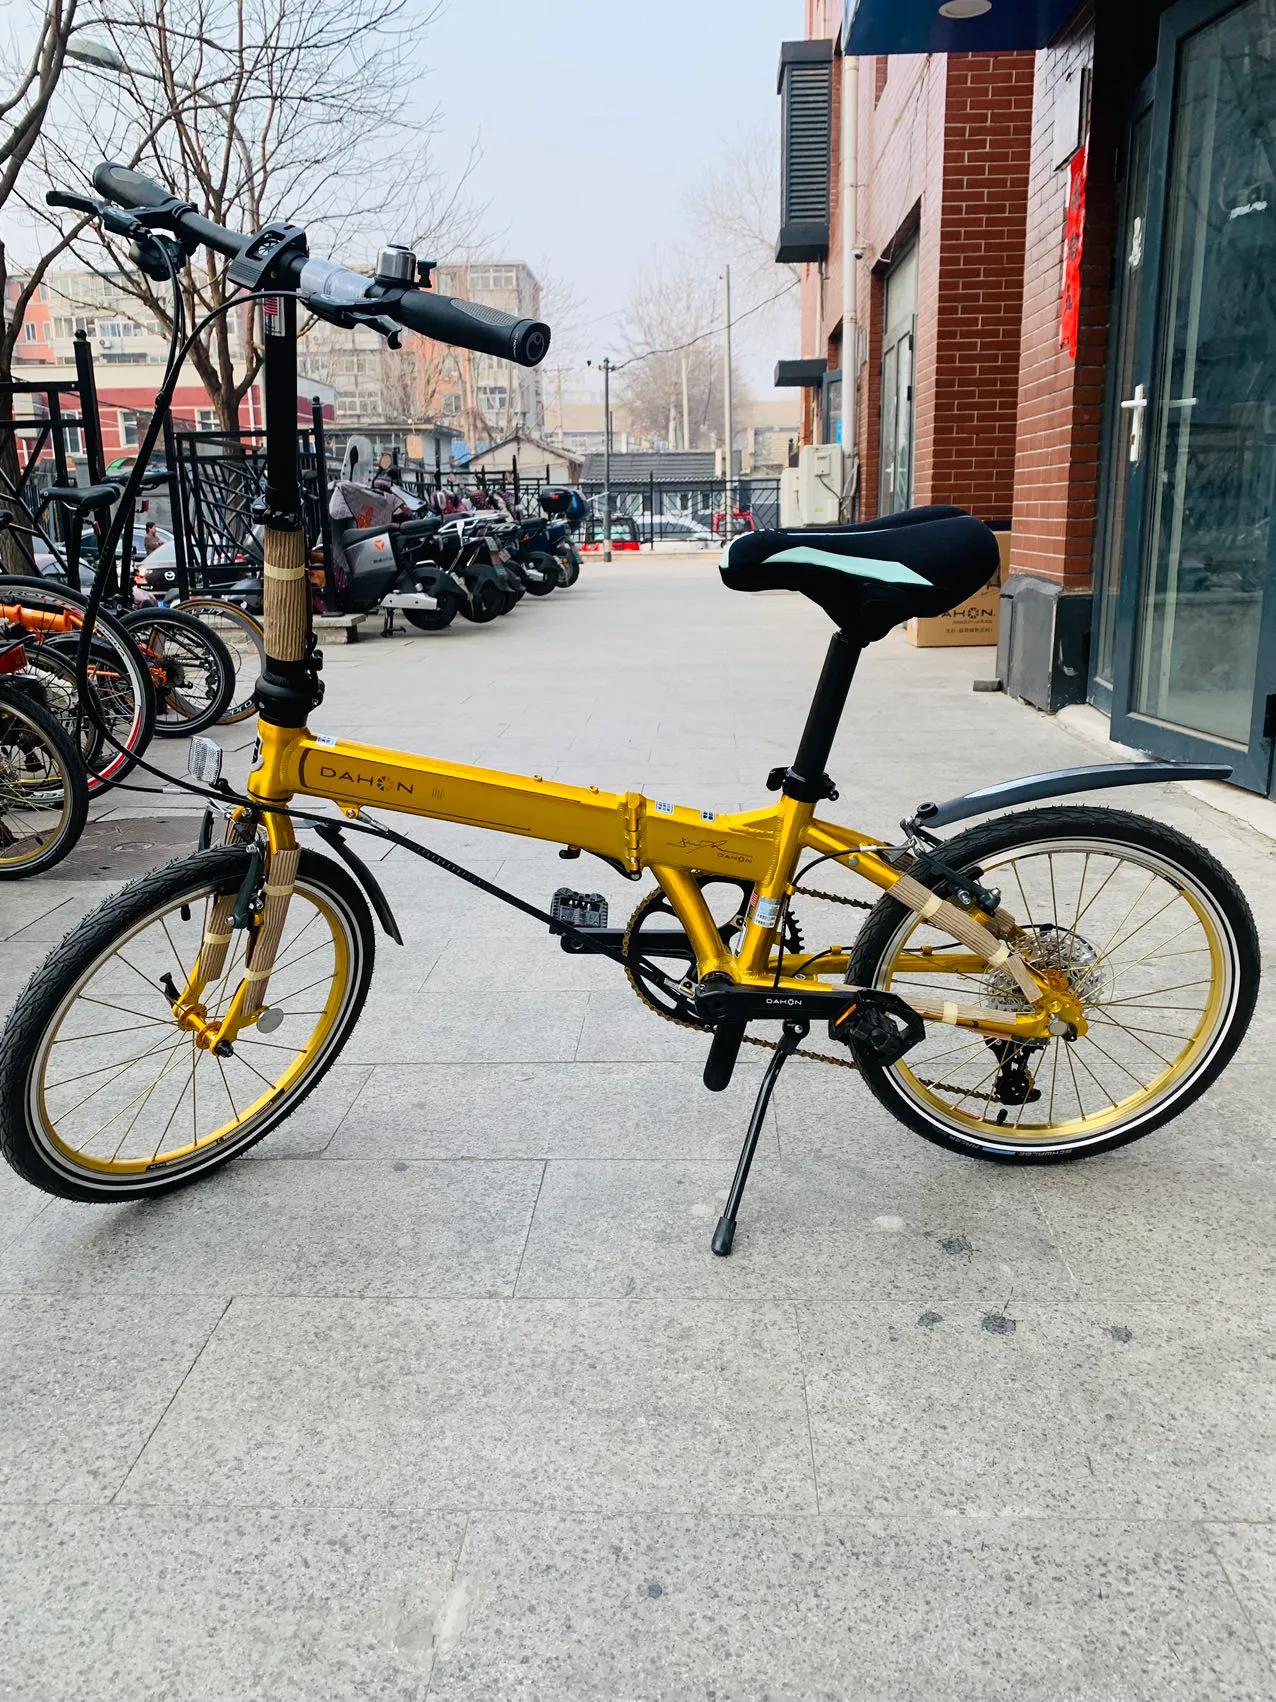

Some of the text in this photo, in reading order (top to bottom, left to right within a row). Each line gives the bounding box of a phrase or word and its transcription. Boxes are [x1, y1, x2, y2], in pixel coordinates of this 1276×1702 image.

[320, 766, 414, 794] DAHON
[717, 852, 752, 863] DAHON
[765, 998, 802, 1006] DAHON
